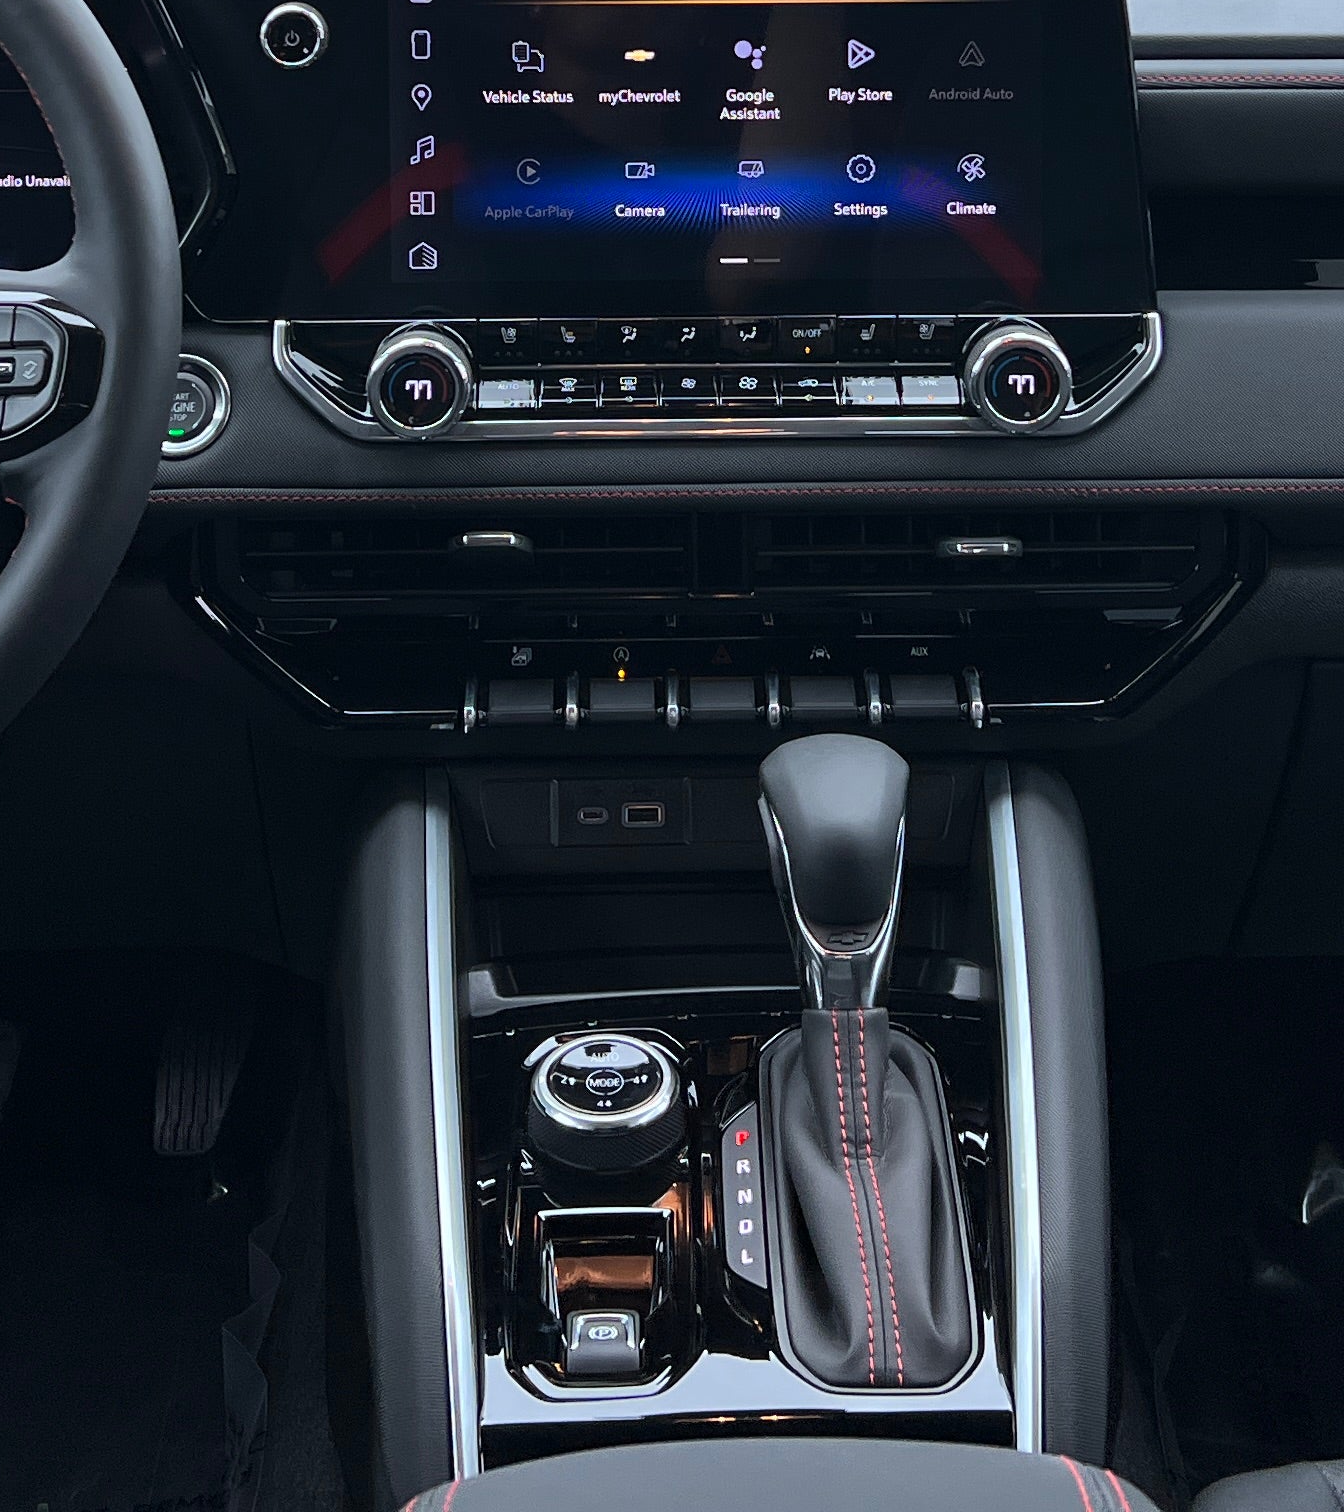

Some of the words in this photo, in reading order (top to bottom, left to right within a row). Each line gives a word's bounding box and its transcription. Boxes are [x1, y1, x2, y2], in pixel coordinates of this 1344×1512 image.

[482, 91, 530, 104] Vehicle
[532, 91, 574, 104] Status
[598, 90, 681, 106] myChevrolet
[726, 88, 774, 105] Google
[828, 88, 853, 105] Play
[855, 88, 893, 102] Store
[928, 87, 980, 101] Android
[983, 88, 1014, 101] Auto
[720, 106, 780, 121] Assistant
[484, 204, 522, 221] Apple
[525, 204, 574, 221] CarPlay
[615, 204, 665, 218] Camera
[720, 202, 780, 220] Trailering
[833, 201, 888, 219] Settings
[946, 200, 997, 215] Climate
[792, 328, 823, 339] ON/OFF
[405, 380, 433, 401] 77
[1008, 374, 1035, 395] 77
[174, 392, 190, 401] ART
[172, 401, 197, 413] GINE
[910, 646, 929, 657] AUX
[589, 1078, 620, 1088] MODE
[735, 1130, 751, 1146] P
[736, 1159, 751, 1175] R
[737, 1188, 753, 1205] N
[738, 1219, 753, 1235] D
[741, 1248, 754, 1264] L
